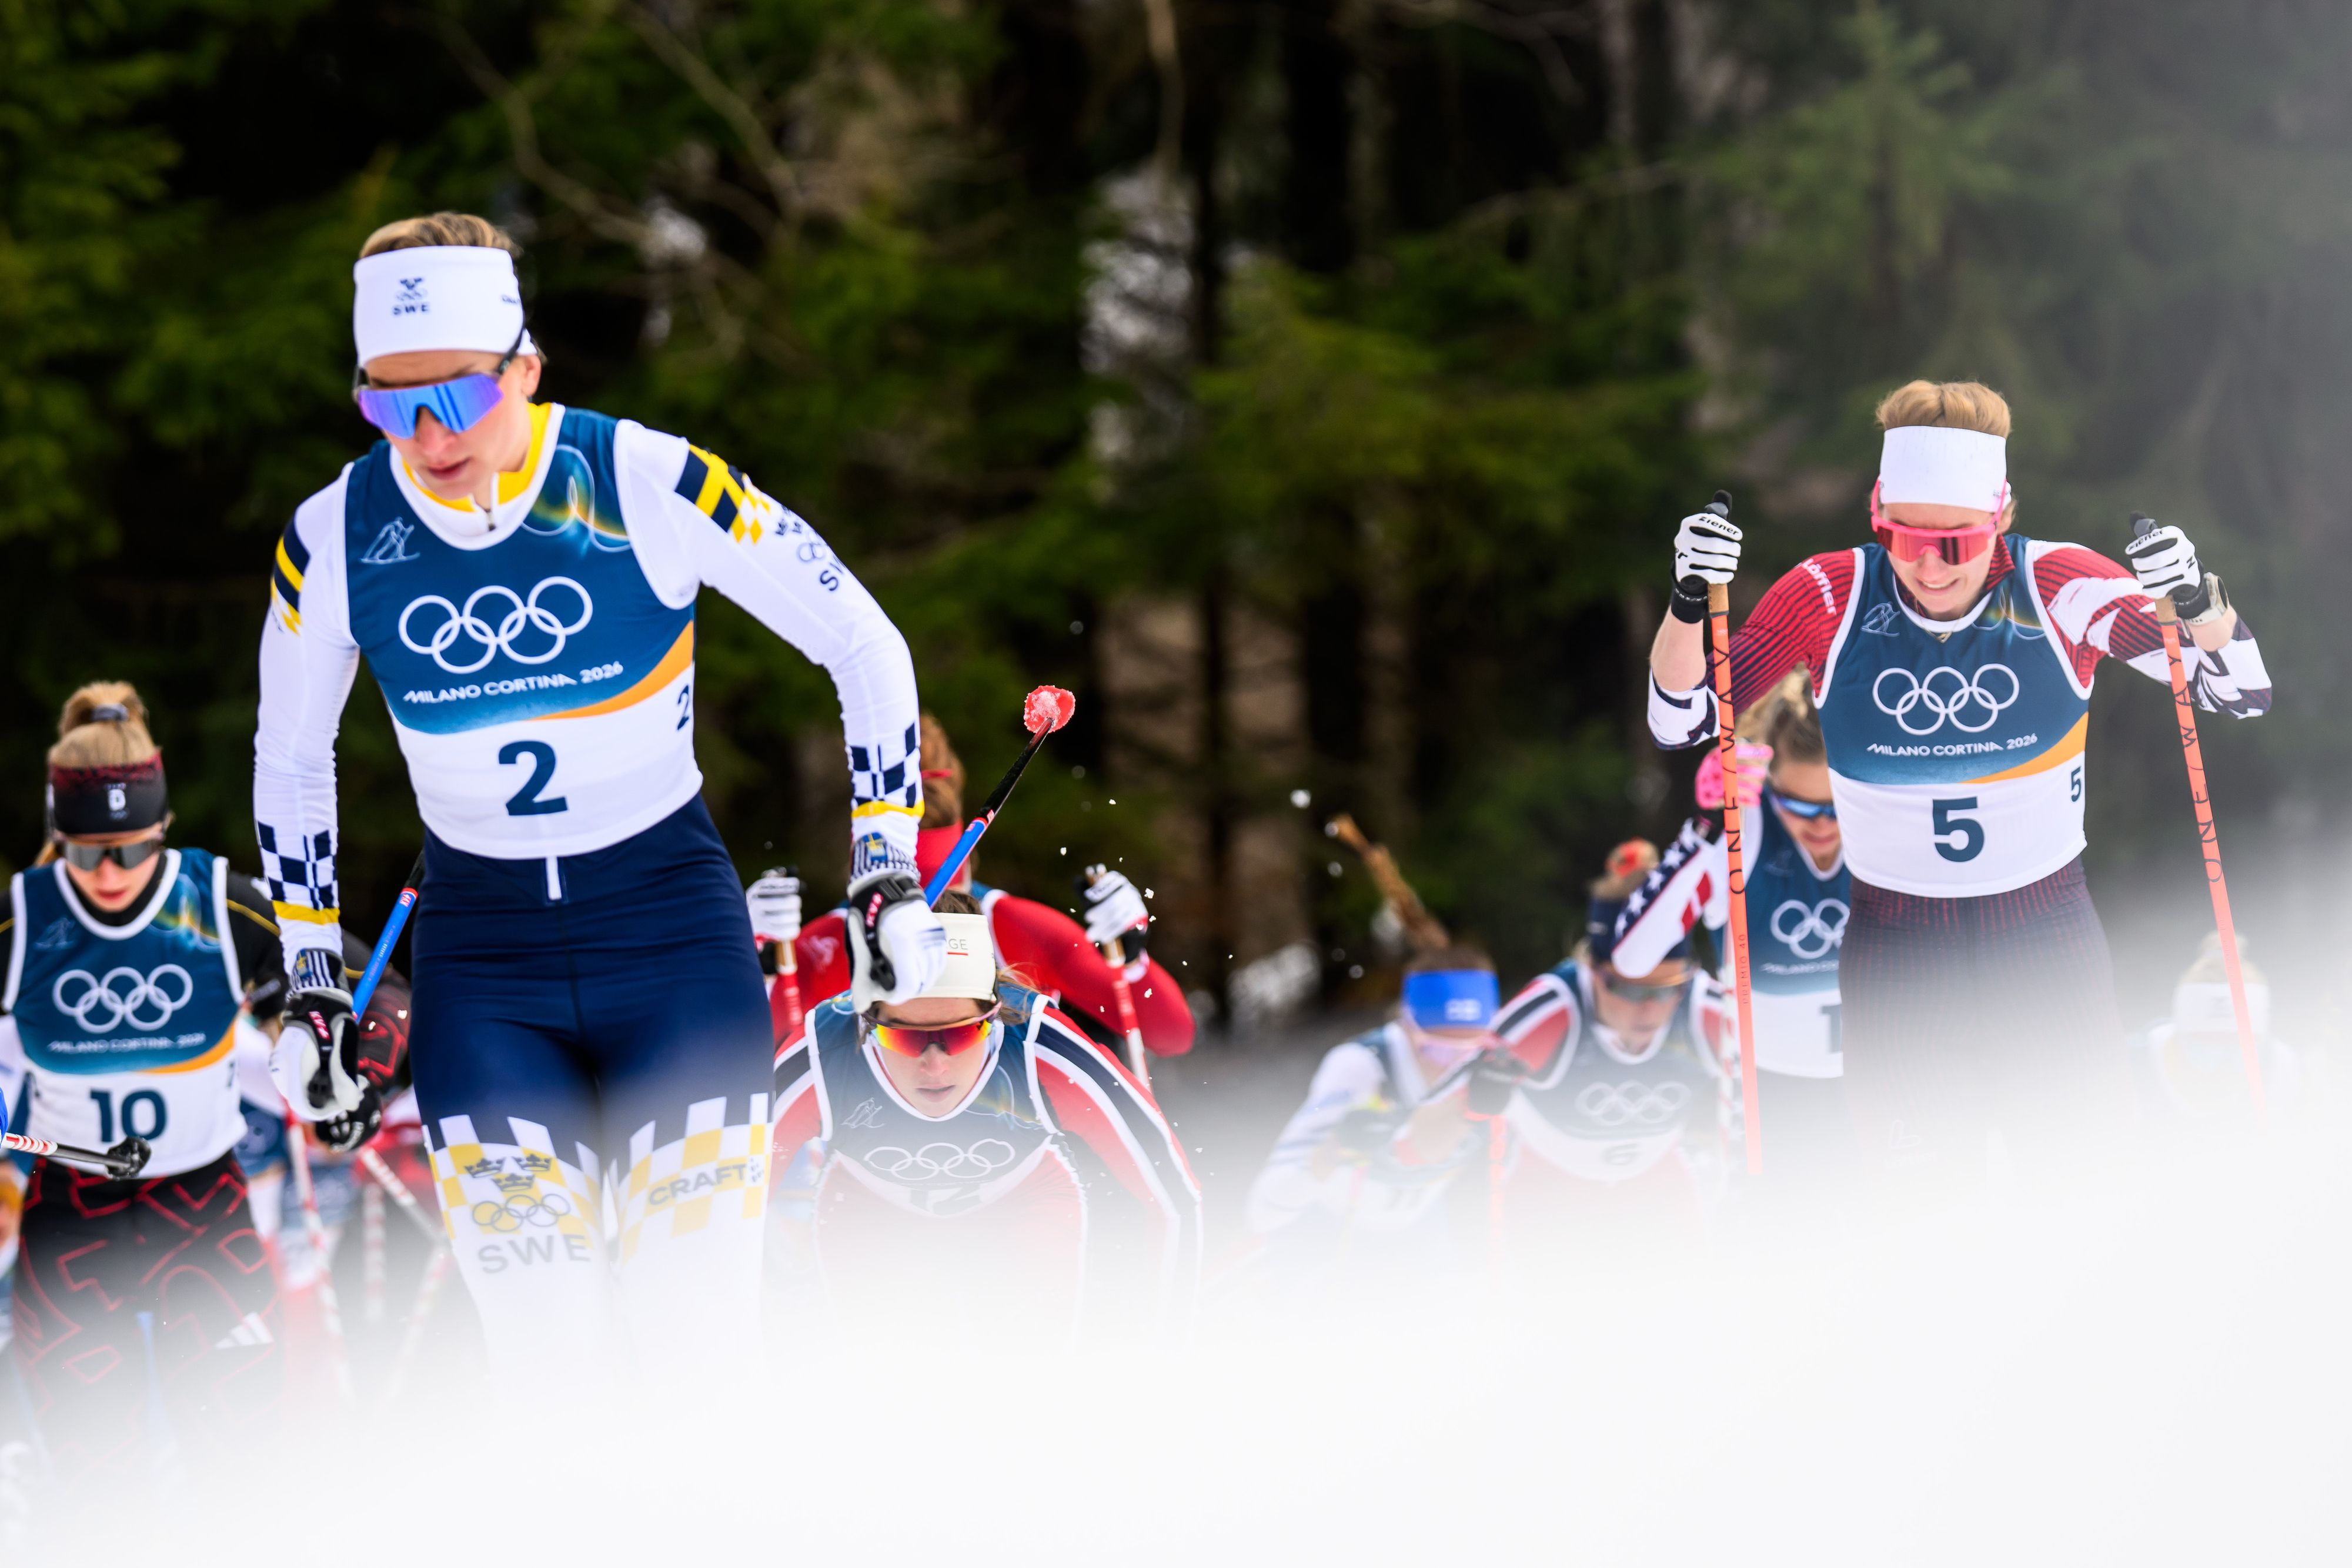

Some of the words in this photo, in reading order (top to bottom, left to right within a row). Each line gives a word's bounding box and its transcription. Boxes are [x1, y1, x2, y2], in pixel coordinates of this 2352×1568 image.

[393, 305, 429, 315] SWE
[403, 684, 482, 704] MILANO
[483, 673, 578, 696] CORTINA
[579, 660, 624, 684] 2026
[676, 685, 690, 731] 2
[1866, 743, 1930, 757] MILANO
[1932, 741, 2004, 755] CORTINA
[2006, 733, 2038, 750] 2026
[498, 739, 569, 816] 2
[2070, 766, 2082, 803] 5
[1932, 796, 1985, 862] 5
[90, 1088, 167, 1142] 10
[649, 1162, 747, 1205] CRAFT
[477, 1234, 591, 1274] SWE
